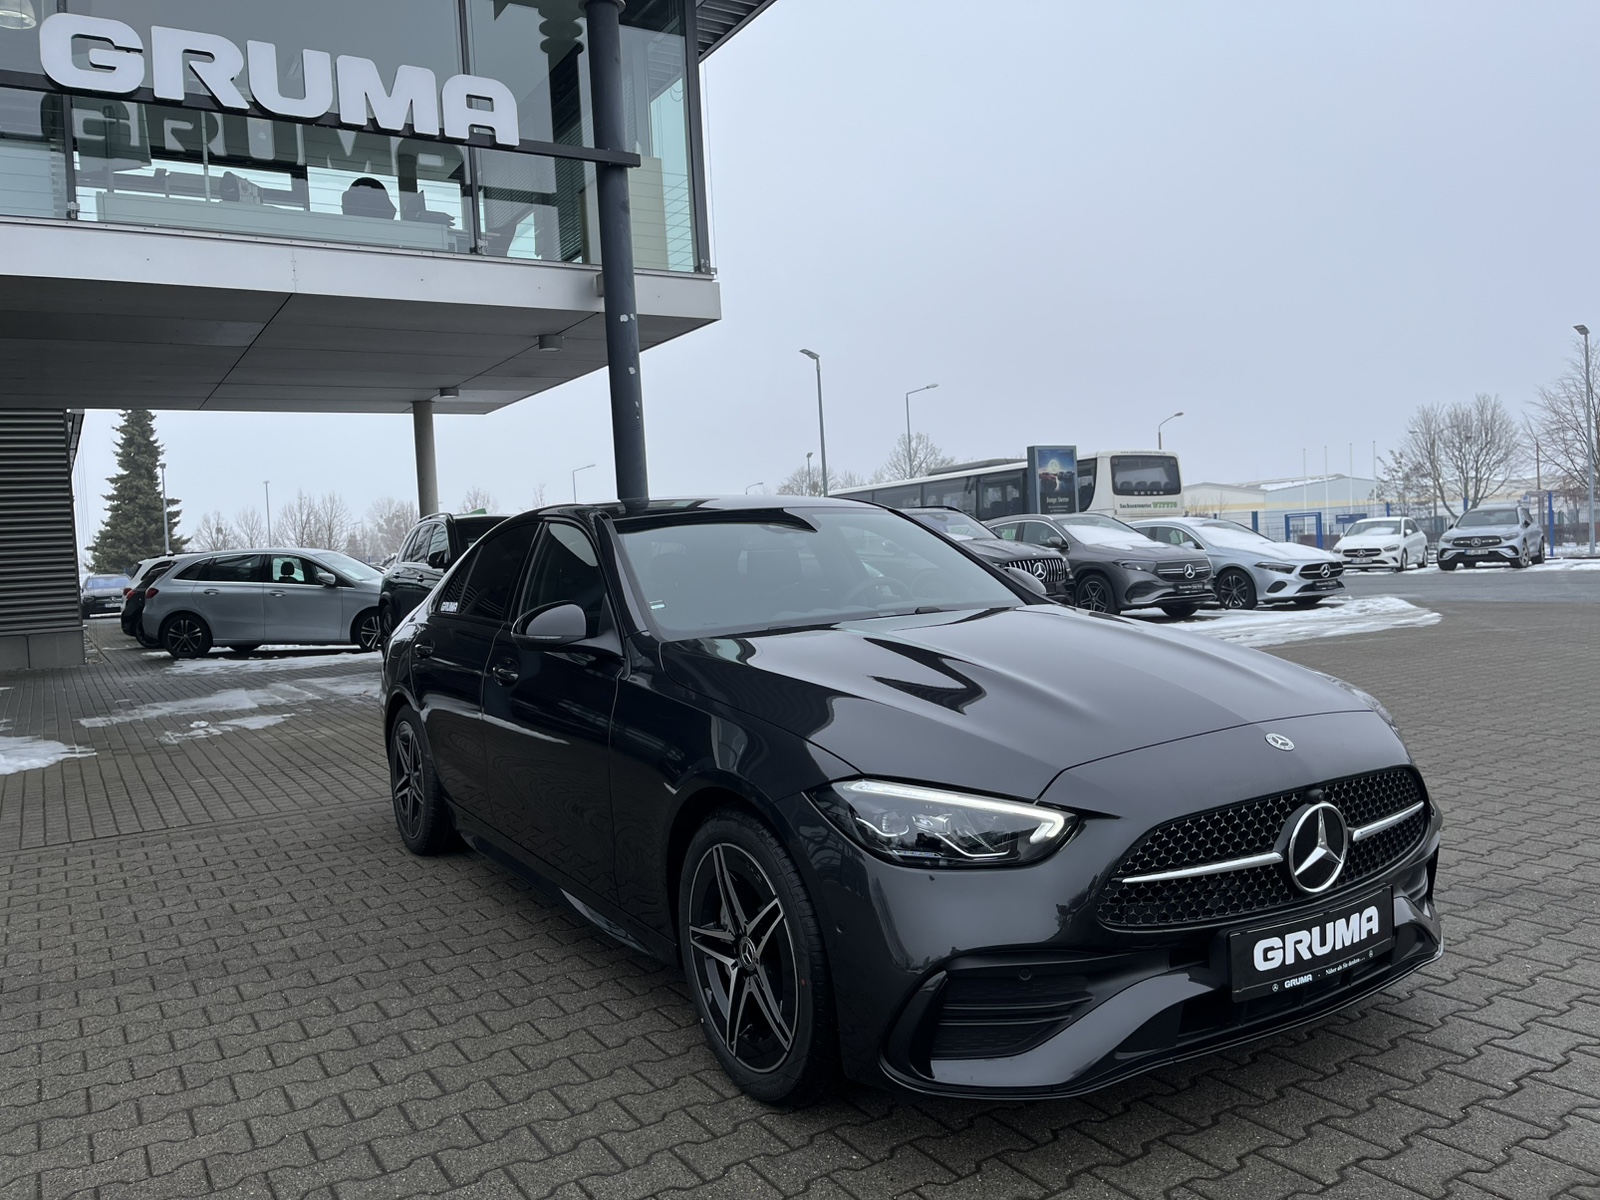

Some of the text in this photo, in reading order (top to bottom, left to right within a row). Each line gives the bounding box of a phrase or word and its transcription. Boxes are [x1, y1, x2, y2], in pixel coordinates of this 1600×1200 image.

[39, 12, 519, 147] GRUMA
[1253, 905, 1379, 972] GRUMA
[1284, 973, 1313, 989] GRUMA
